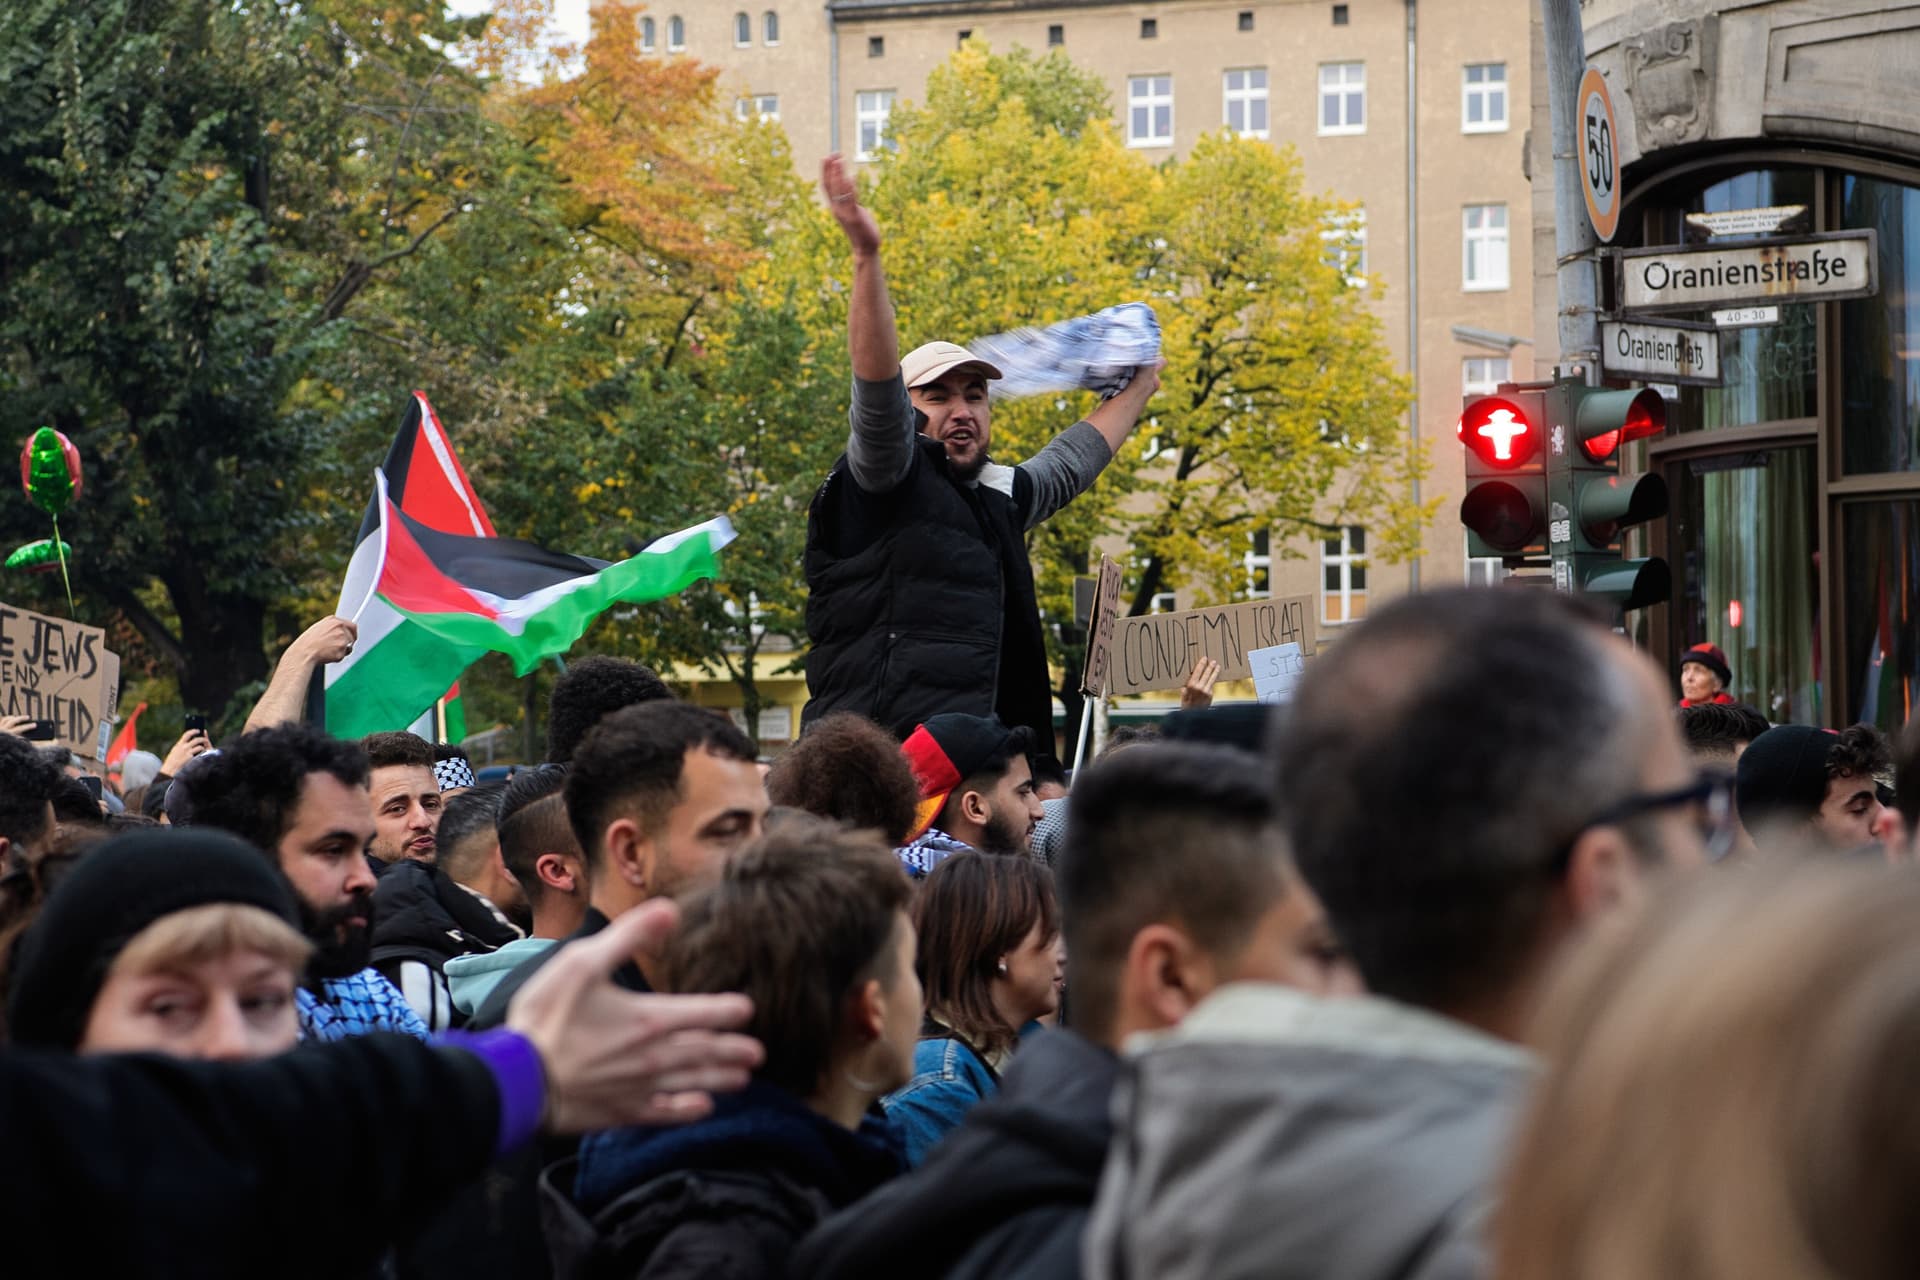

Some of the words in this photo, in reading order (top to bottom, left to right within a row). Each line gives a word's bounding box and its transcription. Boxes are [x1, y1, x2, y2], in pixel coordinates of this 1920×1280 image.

[1586, 114, 1613, 193] 50
[1643, 249, 1848, 291] Oranienstraße
[23, 615, 99, 680] JEWS
[1124, 609, 1243, 687] CONDEMN
